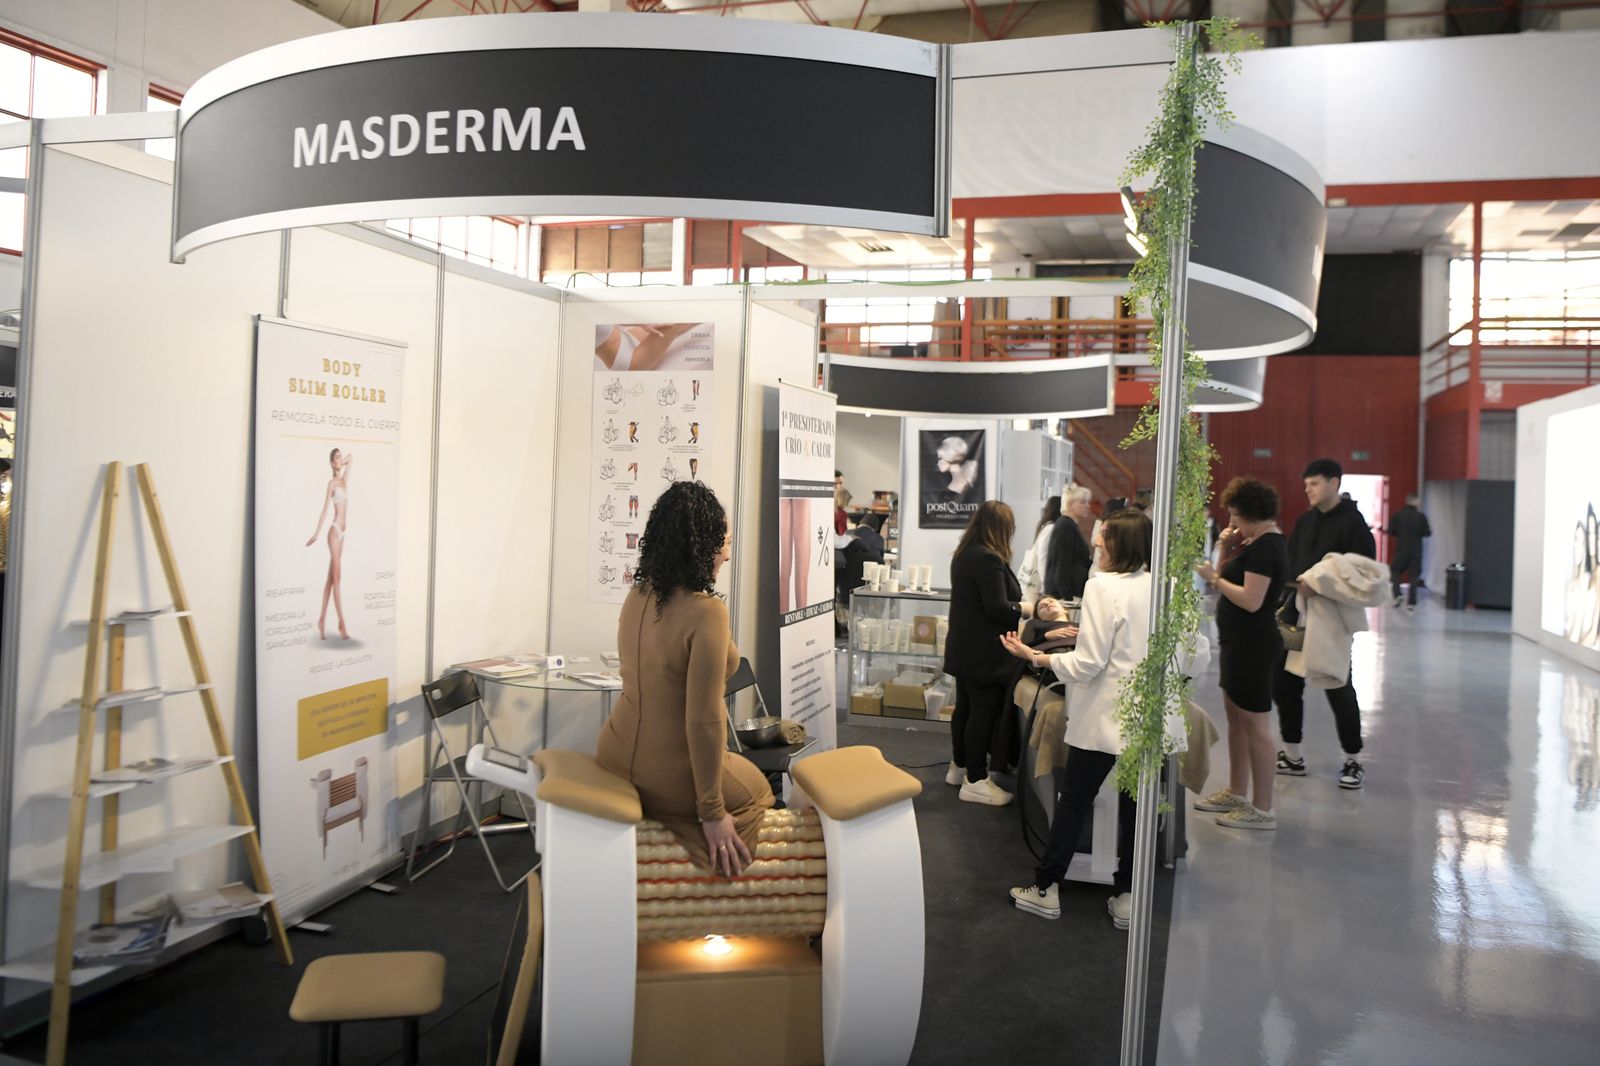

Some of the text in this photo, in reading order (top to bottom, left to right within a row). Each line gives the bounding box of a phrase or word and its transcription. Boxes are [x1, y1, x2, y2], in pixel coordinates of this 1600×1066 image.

[293, 106, 586, 168] MASDERMA
[322, 358, 362, 377] BODY
[288, 377, 387, 404] SLIM ROLLER
[271, 409, 326, 424] REMODELA
[328, 414, 353, 428] TODO
[354, 417, 366, 428] EL
[789, 411, 835, 438] PRESOTERAPIA
[811, 440, 832, 459] CALOR
[926, 501, 978, 514] postQuam
